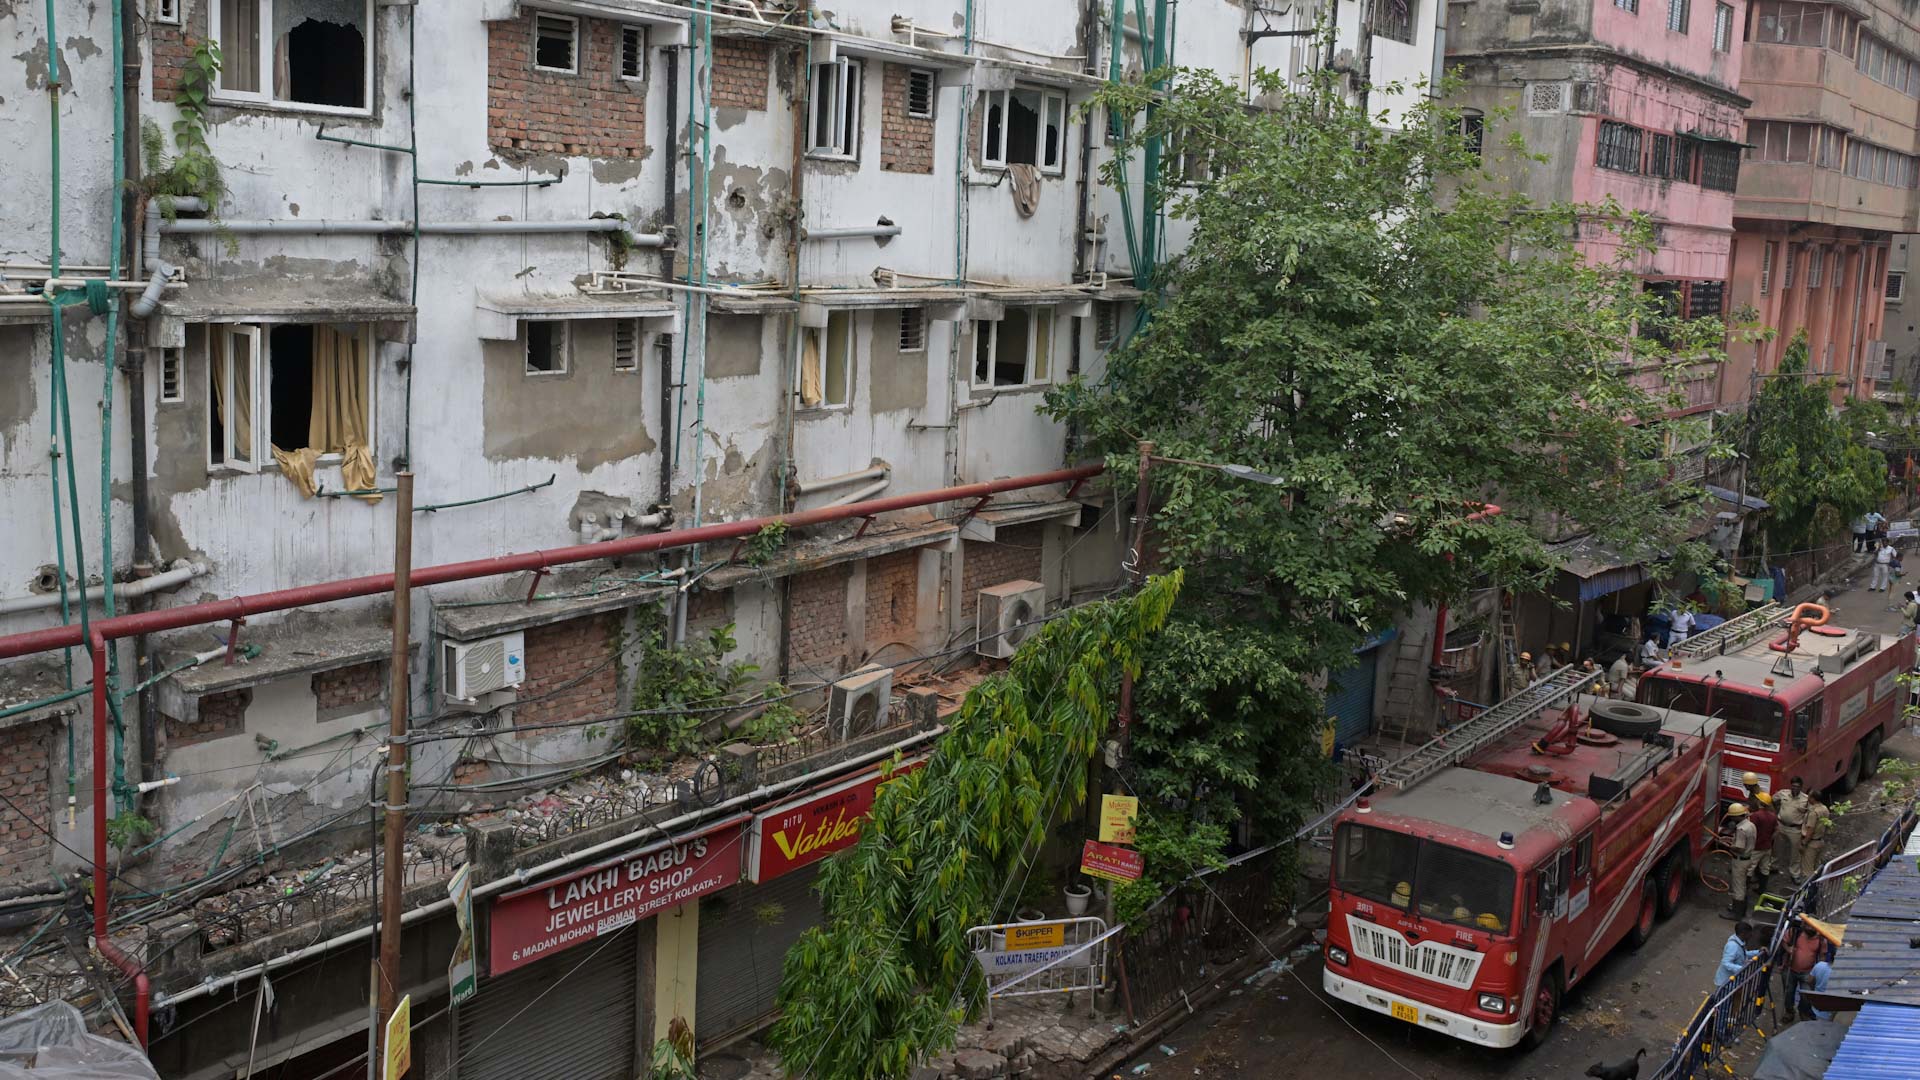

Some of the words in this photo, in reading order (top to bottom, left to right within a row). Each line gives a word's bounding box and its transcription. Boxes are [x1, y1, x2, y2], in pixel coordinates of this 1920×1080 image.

[783, 814, 803, 829] RITU
[772, 807, 861, 861] Vatika
[1086, 851, 1121, 866] ARATI
[548, 867, 618, 910] LAKHI
[628, 837, 709, 881] BABU'S
[545, 884, 645, 933] JEWELLERY
[649, 866, 694, 896] SHOP
[522, 937, 558, 958] MADAN
[559, 923, 595, 944] MOHAN
[598, 907, 636, 928] BURMAN
[638, 893, 673, 914] STREET
[675, 875, 722, 900] KOLKATA-7
[1015, 927, 1053, 938] SKIPPER
[1455, 930, 1473, 942] FIRE
[995, 953, 1022, 966] KOLKATA
[1024, 951, 1049, 964] TRAFFIC
[453, 985, 473, 1005] Ward
